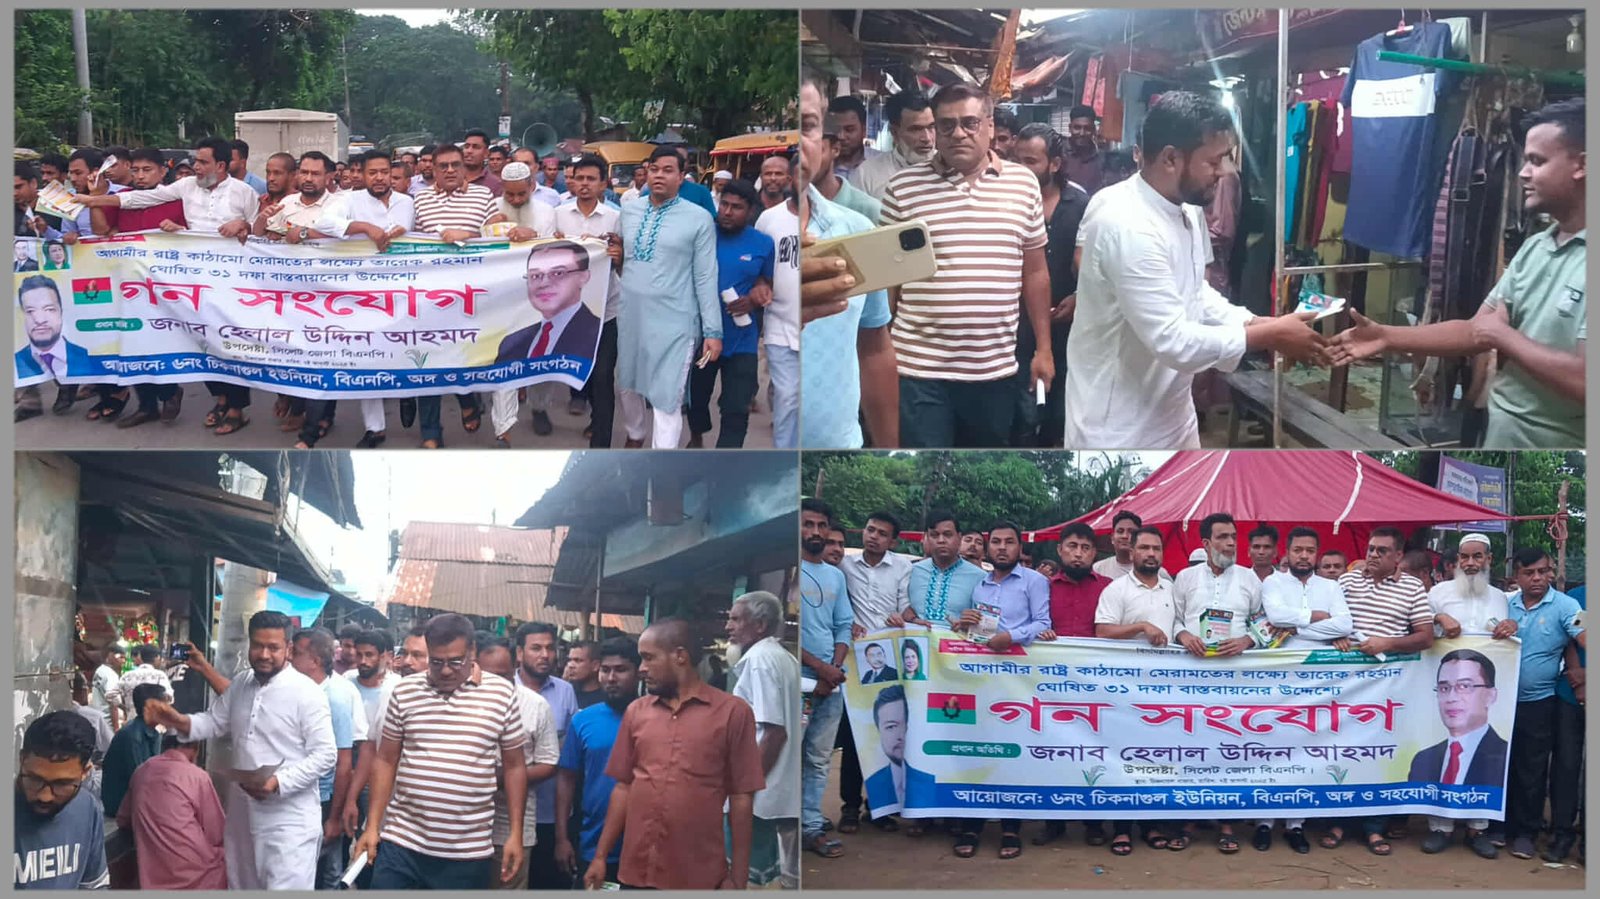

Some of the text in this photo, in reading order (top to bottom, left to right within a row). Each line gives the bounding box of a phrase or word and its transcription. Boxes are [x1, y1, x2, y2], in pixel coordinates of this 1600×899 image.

[96, 246, 147, 259] আগামীর
[187, 250, 243, 264] কাঠামো
[249, 254, 313, 267] মেরামতের
[209, 269, 231, 278] ৩১
[239, 270, 265, 281] দফা
[120, 277, 489, 319] গন সংযোগ
[219, 324, 295, 343] হেলাল
[302, 325, 376, 345] উদ্দিন
[381, 328, 482, 346] আহমদ
[443, 372, 458, 382] ও
[463, 360, 525, 381] সহযোগী
[529, 354, 583, 375] সংগঠন
[959, 661, 1404, 680] আগামীর রাষ্ট্র কাঠামো মেরামতের লক্ষ্যে তারেক রহমান
[1036, 680, 1343, 696] ঘোষিত ৩১ দফা বাস্তবায়নের উদ্দেশ্যে
[989, 695, 1405, 736] গন সংযোগ
[1026, 741, 1398, 763] জনাব হেলাল উদ্দিন আহমদ
[1183, 764, 1221, 775] সিলেট
[1225, 766, 1256, 775] জেলা
[1260, 764, 1306, 775] বিএনপি
[1050, 791, 1087, 806] ৬নং
[1090, 789, 1169, 806] চিকনাগুল
[1172, 788, 1247, 807] ইউনিয়ন,
[1251, 787, 1321, 807] বিএনপি,
[1325, 790, 1357, 803] অঙ্গ
[1360, 789, 1375, 802] ও
[1379, 783, 1440, 801] সহযোগী
[1441, 786, 1492, 805] সংগঠন
